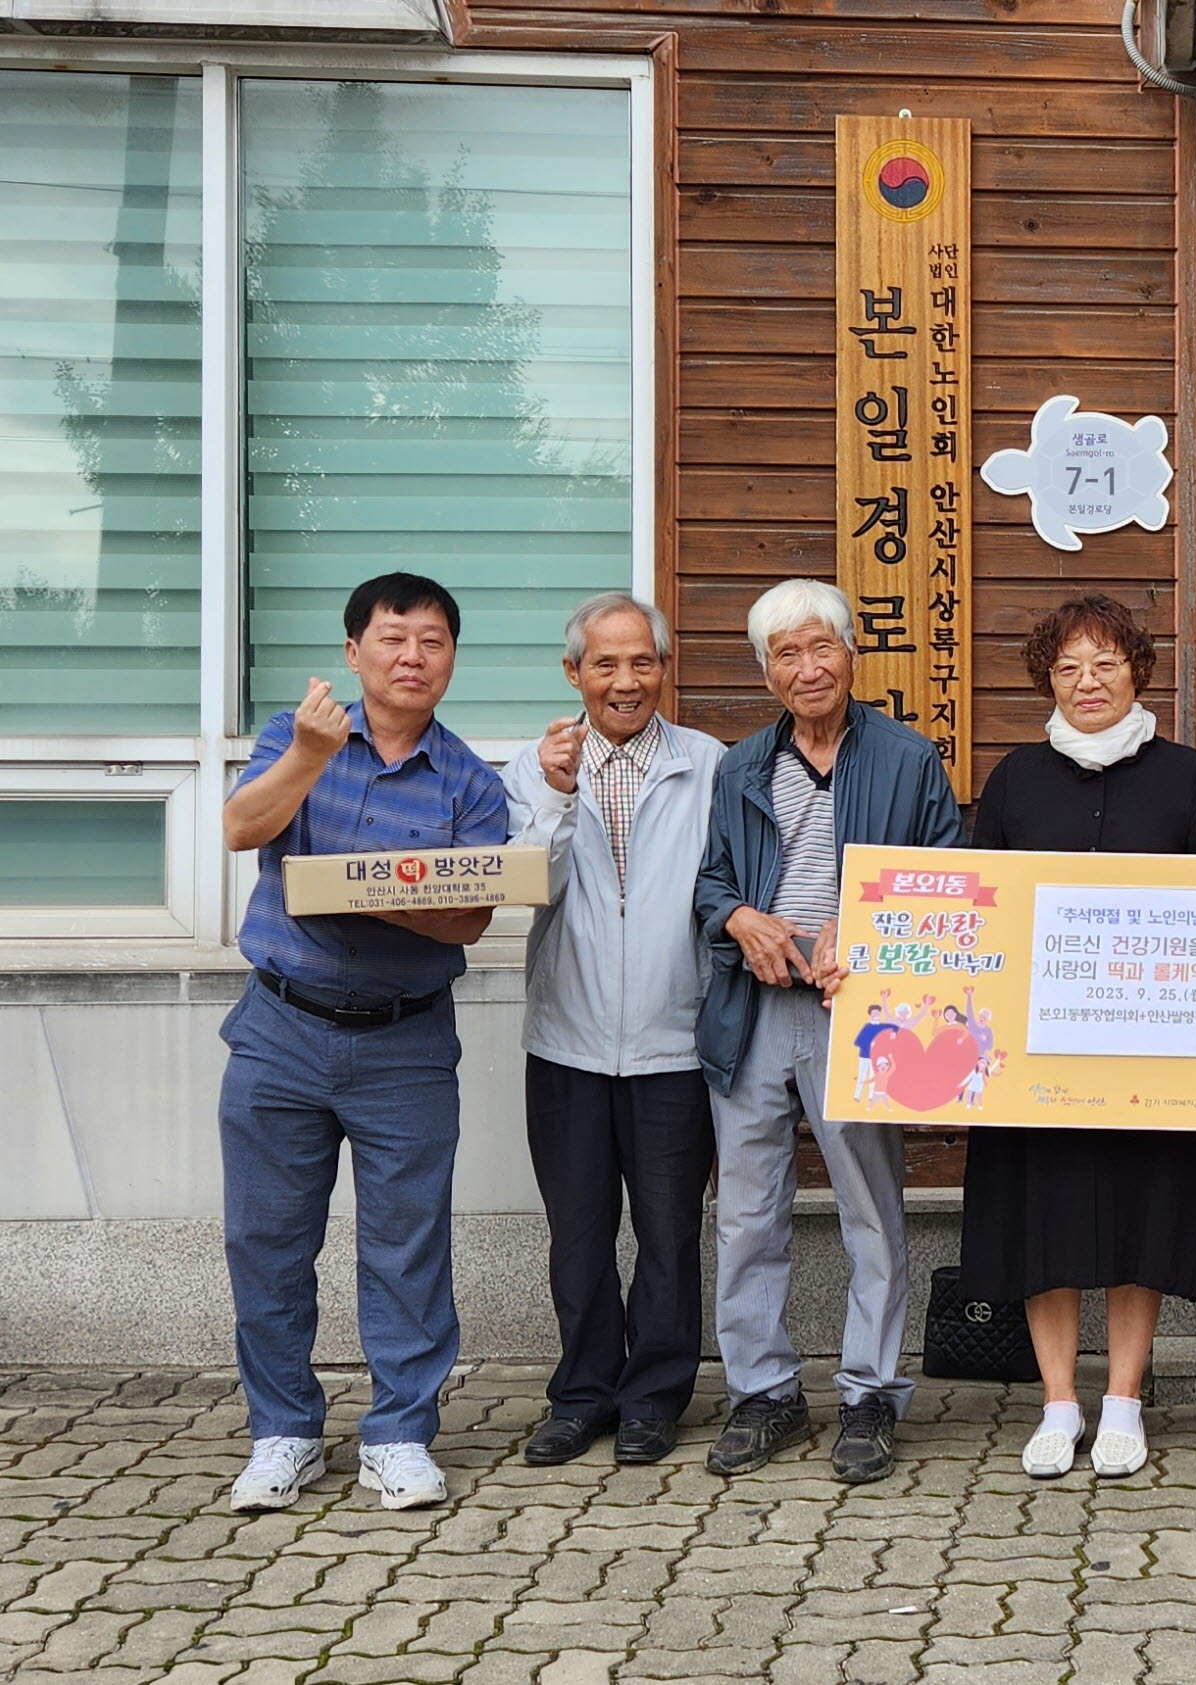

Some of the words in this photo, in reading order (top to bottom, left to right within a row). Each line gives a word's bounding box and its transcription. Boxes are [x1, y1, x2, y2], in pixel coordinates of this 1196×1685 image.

[928, 243, 960, 260] 사단
[928, 263, 959, 279] 법인
[929, 285, 960, 463] 대한노인회
[1072, 433, 1109, 446] 샘골로
[1065, 466, 1115, 496] 7-1
[1068, 504, 1112, 515] 본일경로당
[346, 859, 392, 881] 대성
[399, 859, 421, 882] 떡
[434, 855, 504, 877] 방앗간
[366, 885, 396, 897] 안산시
[473, 882, 486, 891] 35
[892, 872, 967, 896] 본오1동
[1127, 908, 1141, 925] 및
[873, 912, 912, 936] 작은
[917, 911, 985, 947] 사랑
[1045, 934, 1101, 955] 어르신
[848, 945, 869, 971] 큰
[877, 943, 939, 974] 보람
[941, 952, 1005, 975] 나누기
[1042, 960, 1097, 981] 사랑의
[1107, 961, 1144, 982] 떡과
[1085, 986, 1129, 1001] 2023.
[1137, 986, 1151, 1001] 9.
